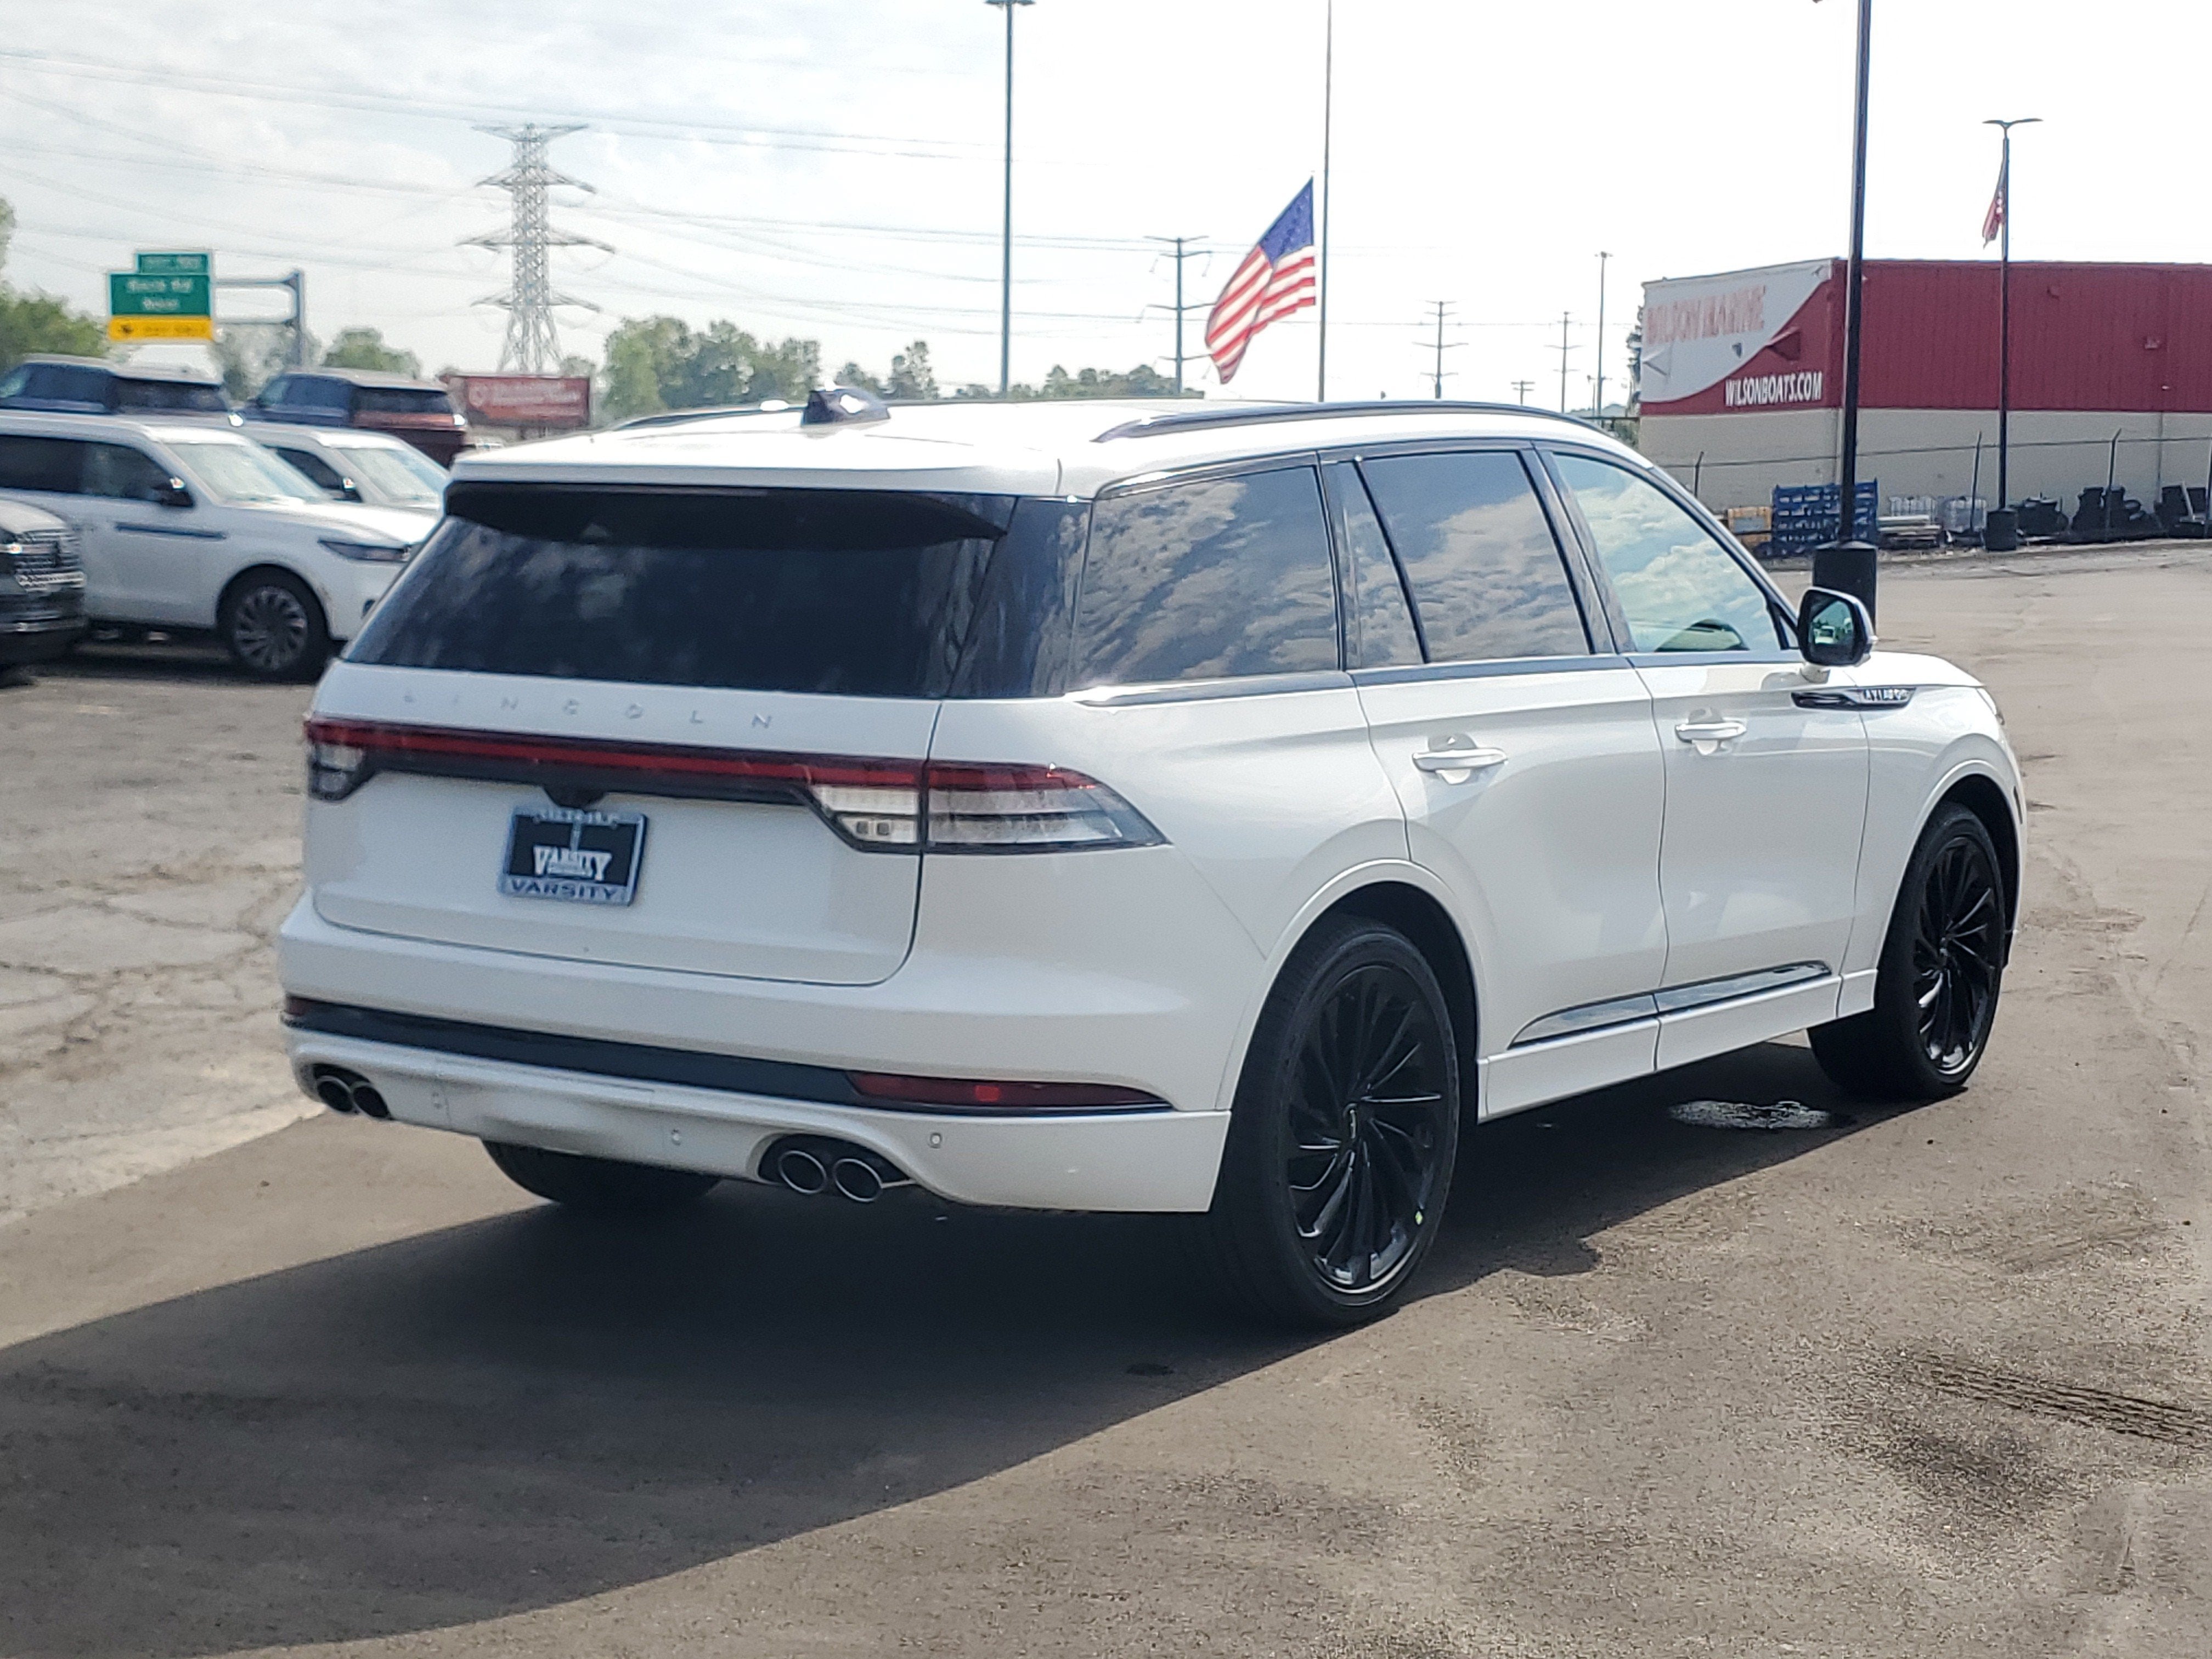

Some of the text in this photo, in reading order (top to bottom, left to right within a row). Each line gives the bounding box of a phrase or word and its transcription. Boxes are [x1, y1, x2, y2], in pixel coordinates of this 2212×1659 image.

[1725, 371, 1822, 407] WILSONBOATS.COM
[403, 692, 772, 729] LINCOLN
[511, 879, 617, 899] VARSITY
